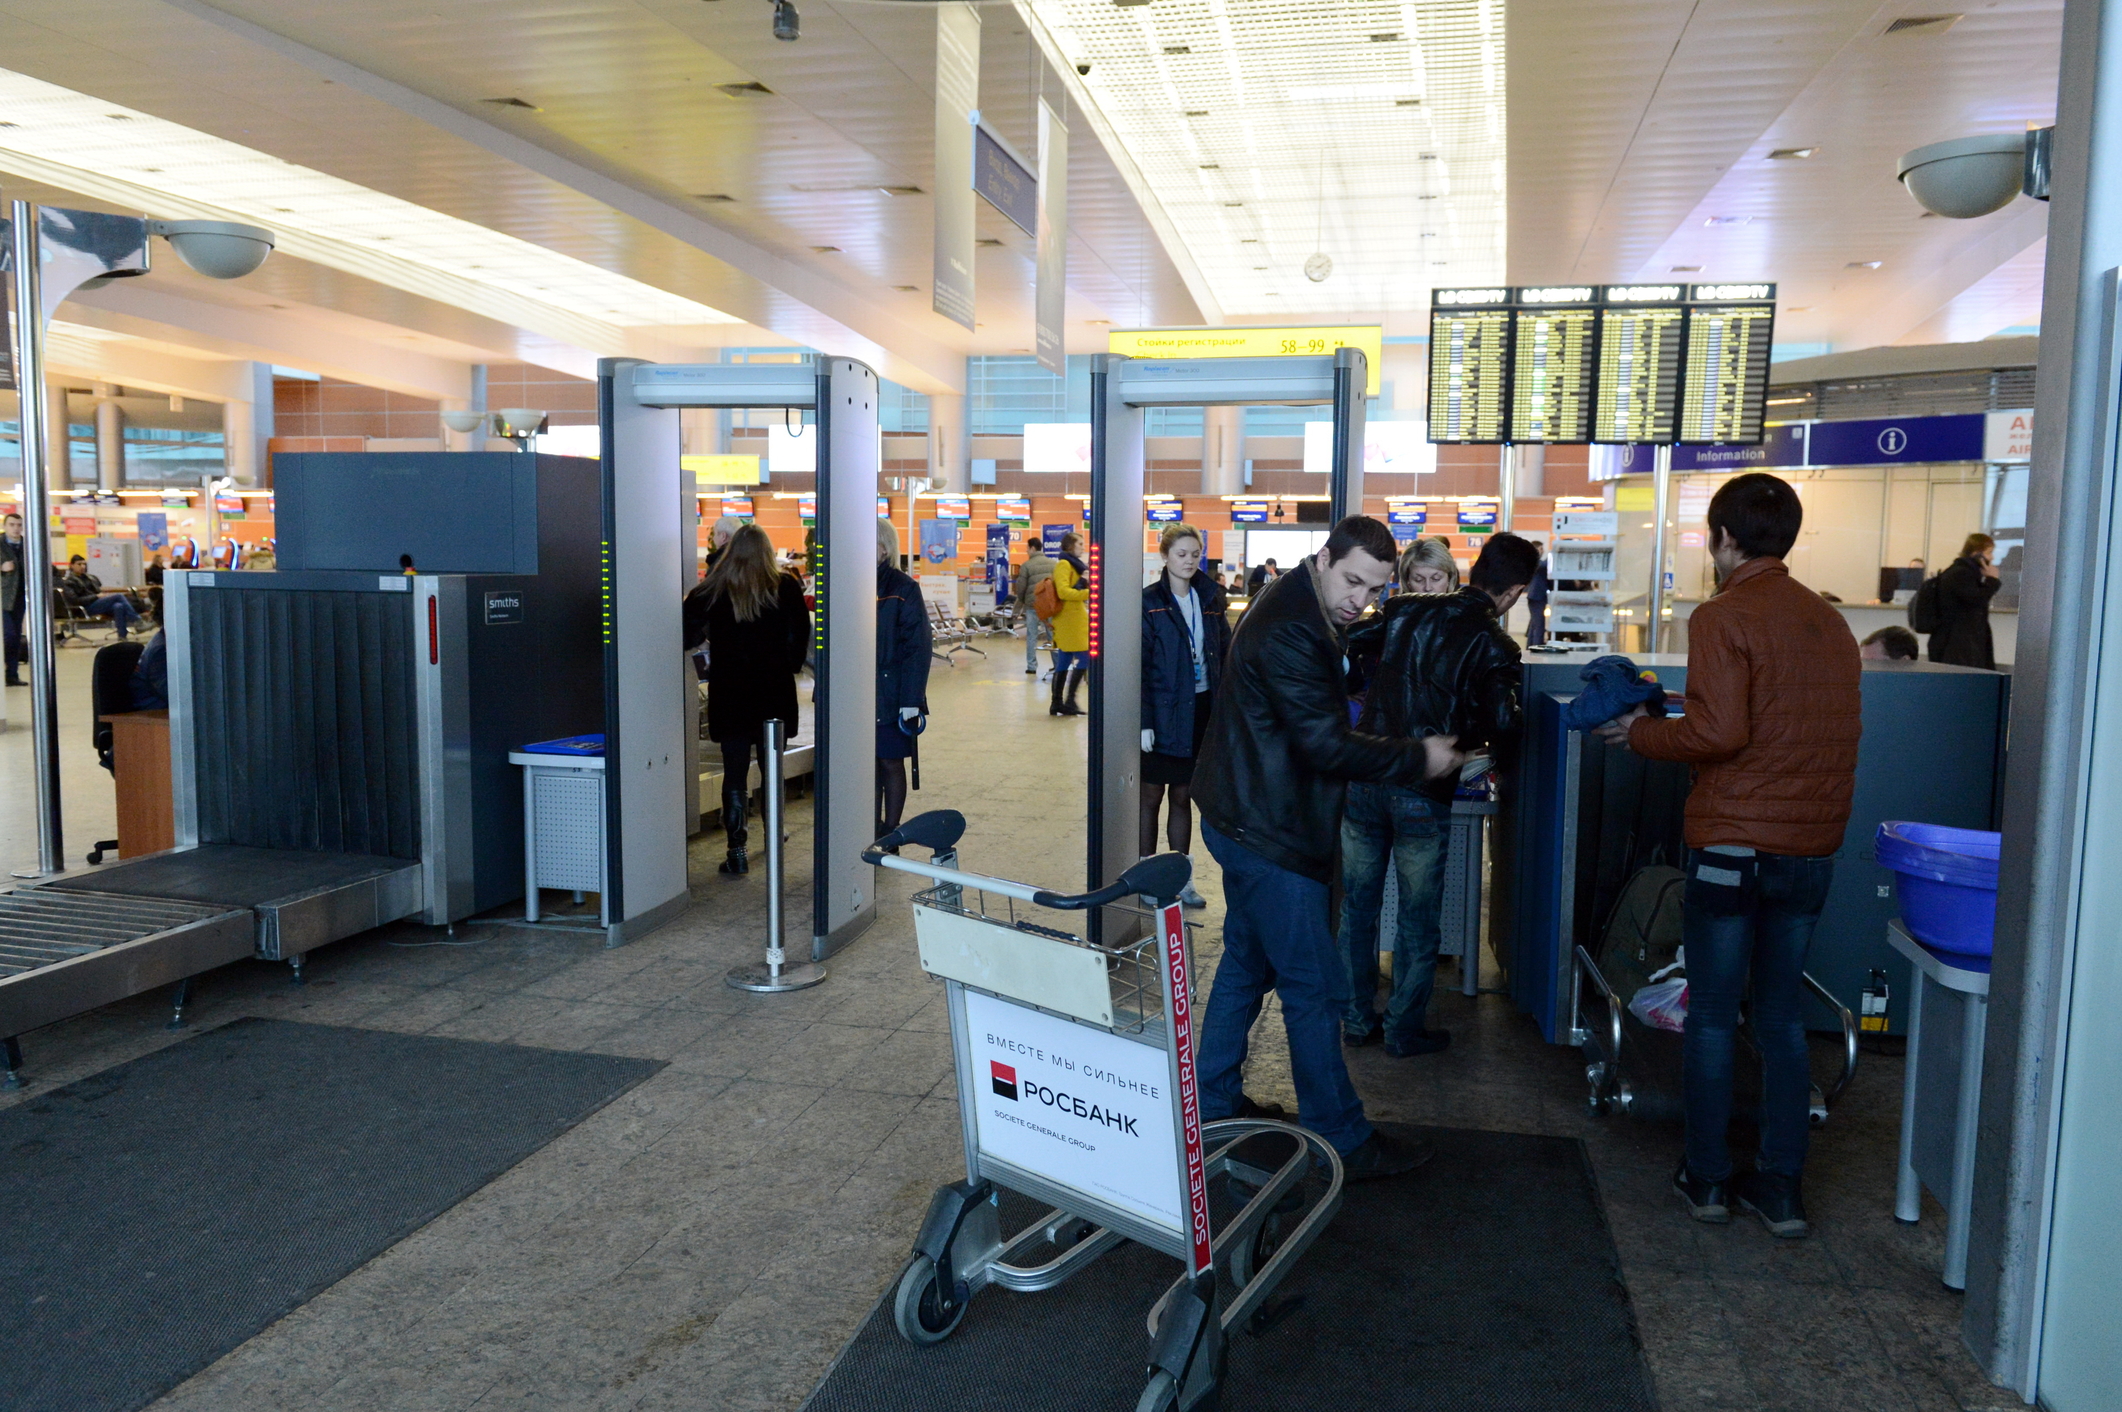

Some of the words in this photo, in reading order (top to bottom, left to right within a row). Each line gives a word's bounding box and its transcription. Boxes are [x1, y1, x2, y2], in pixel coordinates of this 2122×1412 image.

[1137, 338, 1175, 347] Стойки
[1177, 338, 1246, 348] регистрации
[1696, 449, 1766, 462] Information
[1009, 532, 1020, 540] 70
[1044, 541, 1062, 549] DROP
[1470, 536, 1482, 546] 76
[489, 597, 519, 609] smiths
[1169, 932, 1187, 1016] GROUP
[987, 1033, 1044, 1061] ВМЕСТЕ
[1051, 1054, 1075, 1071] МЫ
[1083, 1065, 1160, 1099] СИЛЬНЕЕ
[1177, 1019, 1198, 1145] GENERALE
[1024, 1080, 1140, 1138] РОСБАНК
[994, 1109, 1025, 1127] SOCIETE
[1026, 1122, 1067, 1142] GENERALE
[1068, 1137, 1096, 1152] GROUP
[1188, 1147, 1206, 1246] SOCIETE
